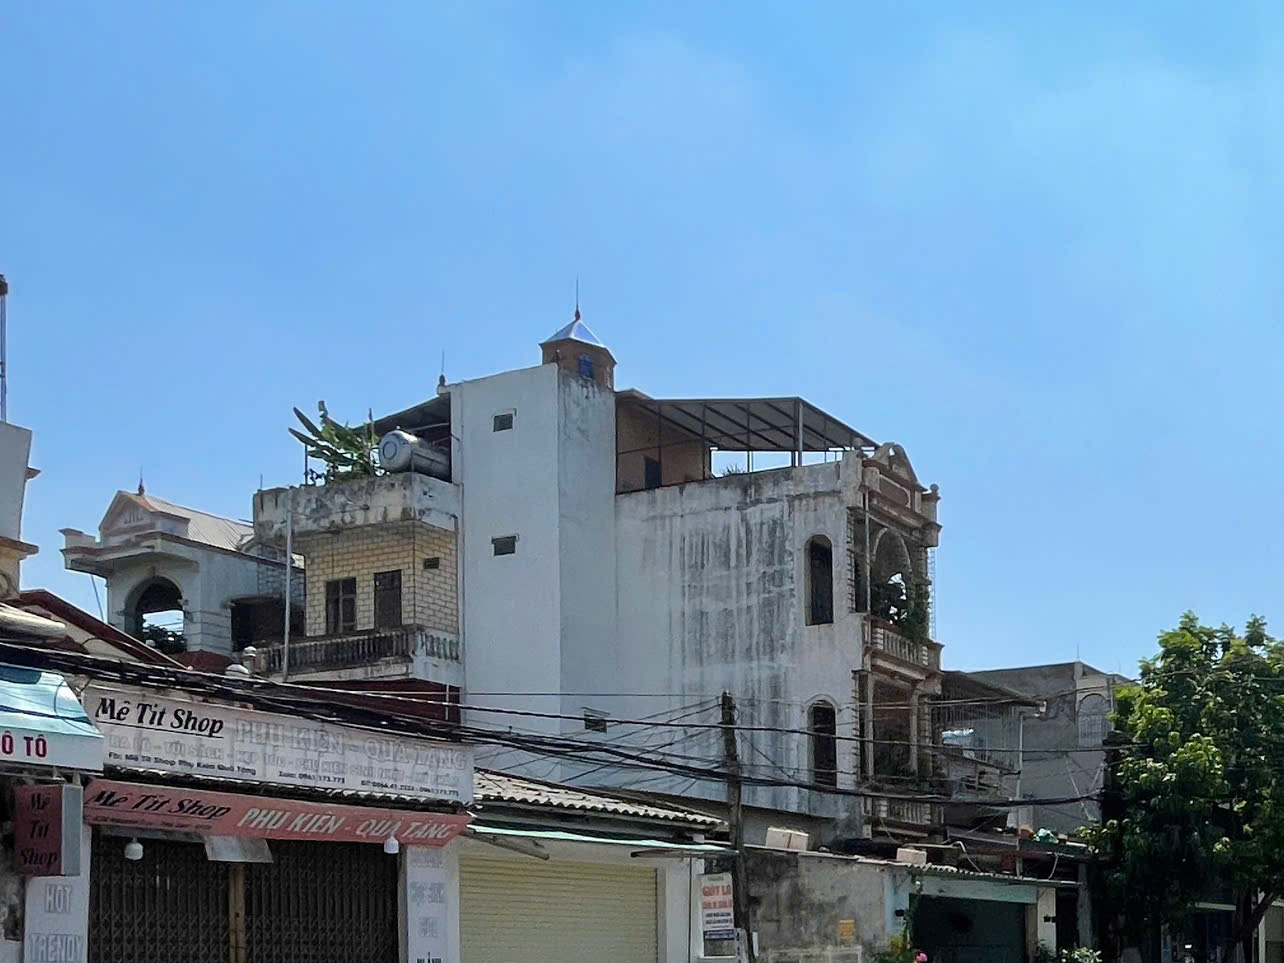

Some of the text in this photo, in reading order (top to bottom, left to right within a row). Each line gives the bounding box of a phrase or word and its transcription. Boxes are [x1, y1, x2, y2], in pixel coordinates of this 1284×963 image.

[171, 708, 224, 737] Shop
[23, 734, 48, 758] TÔ
[168, 798, 232, 820] Shop
[44, 884, 72, 914] HOT
[30, 933, 82, 963] TRENDY
